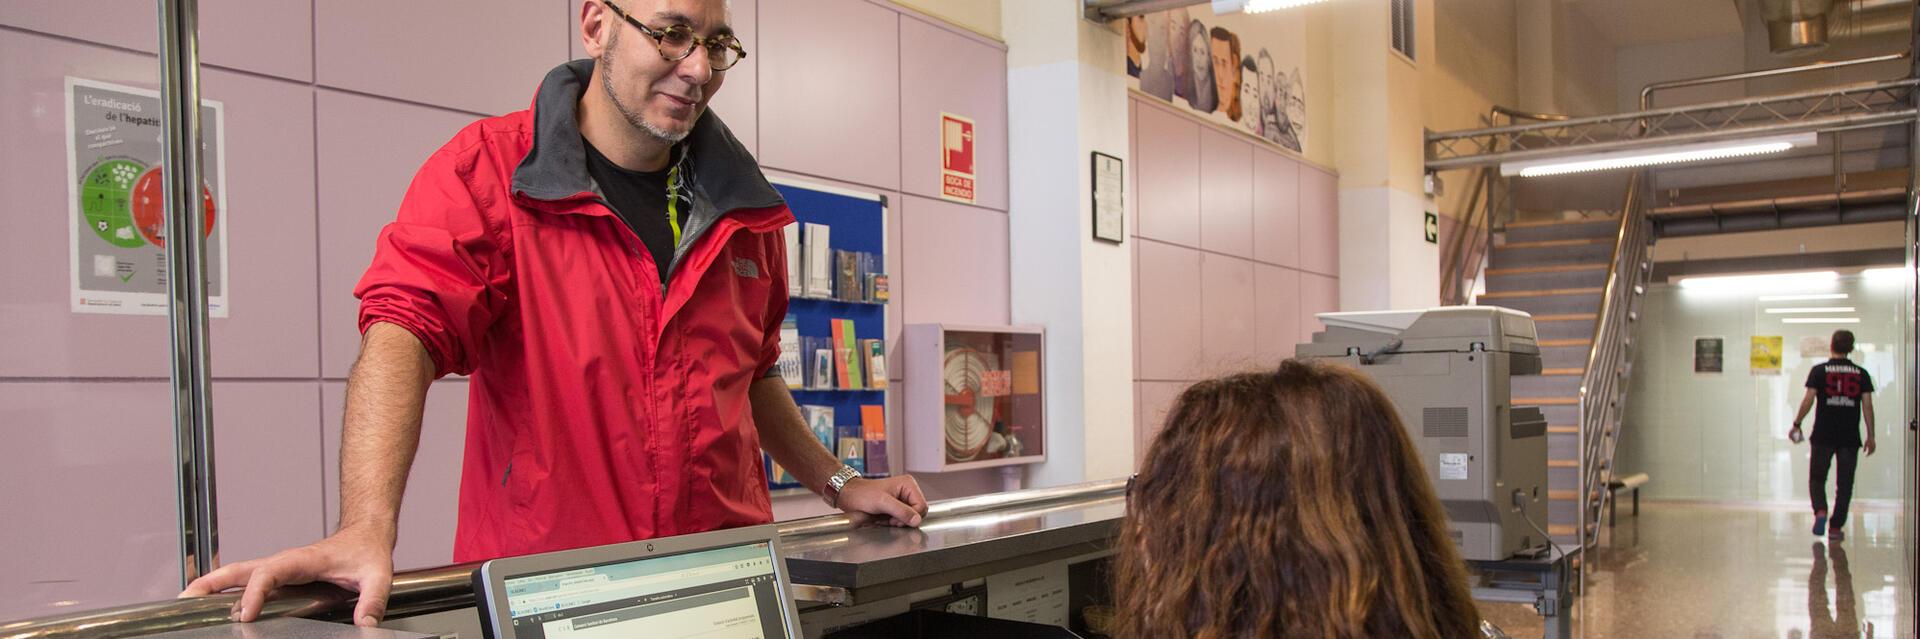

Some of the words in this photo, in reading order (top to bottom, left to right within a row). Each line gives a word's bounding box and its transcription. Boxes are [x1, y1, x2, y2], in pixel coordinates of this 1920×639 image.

[84, 95, 142, 113] L'eradicació
[105, 111, 118, 122] de
[945, 175, 962, 186] BOCA
[963, 179, 972, 189] DE
[945, 185, 972, 198] INCENDIO
